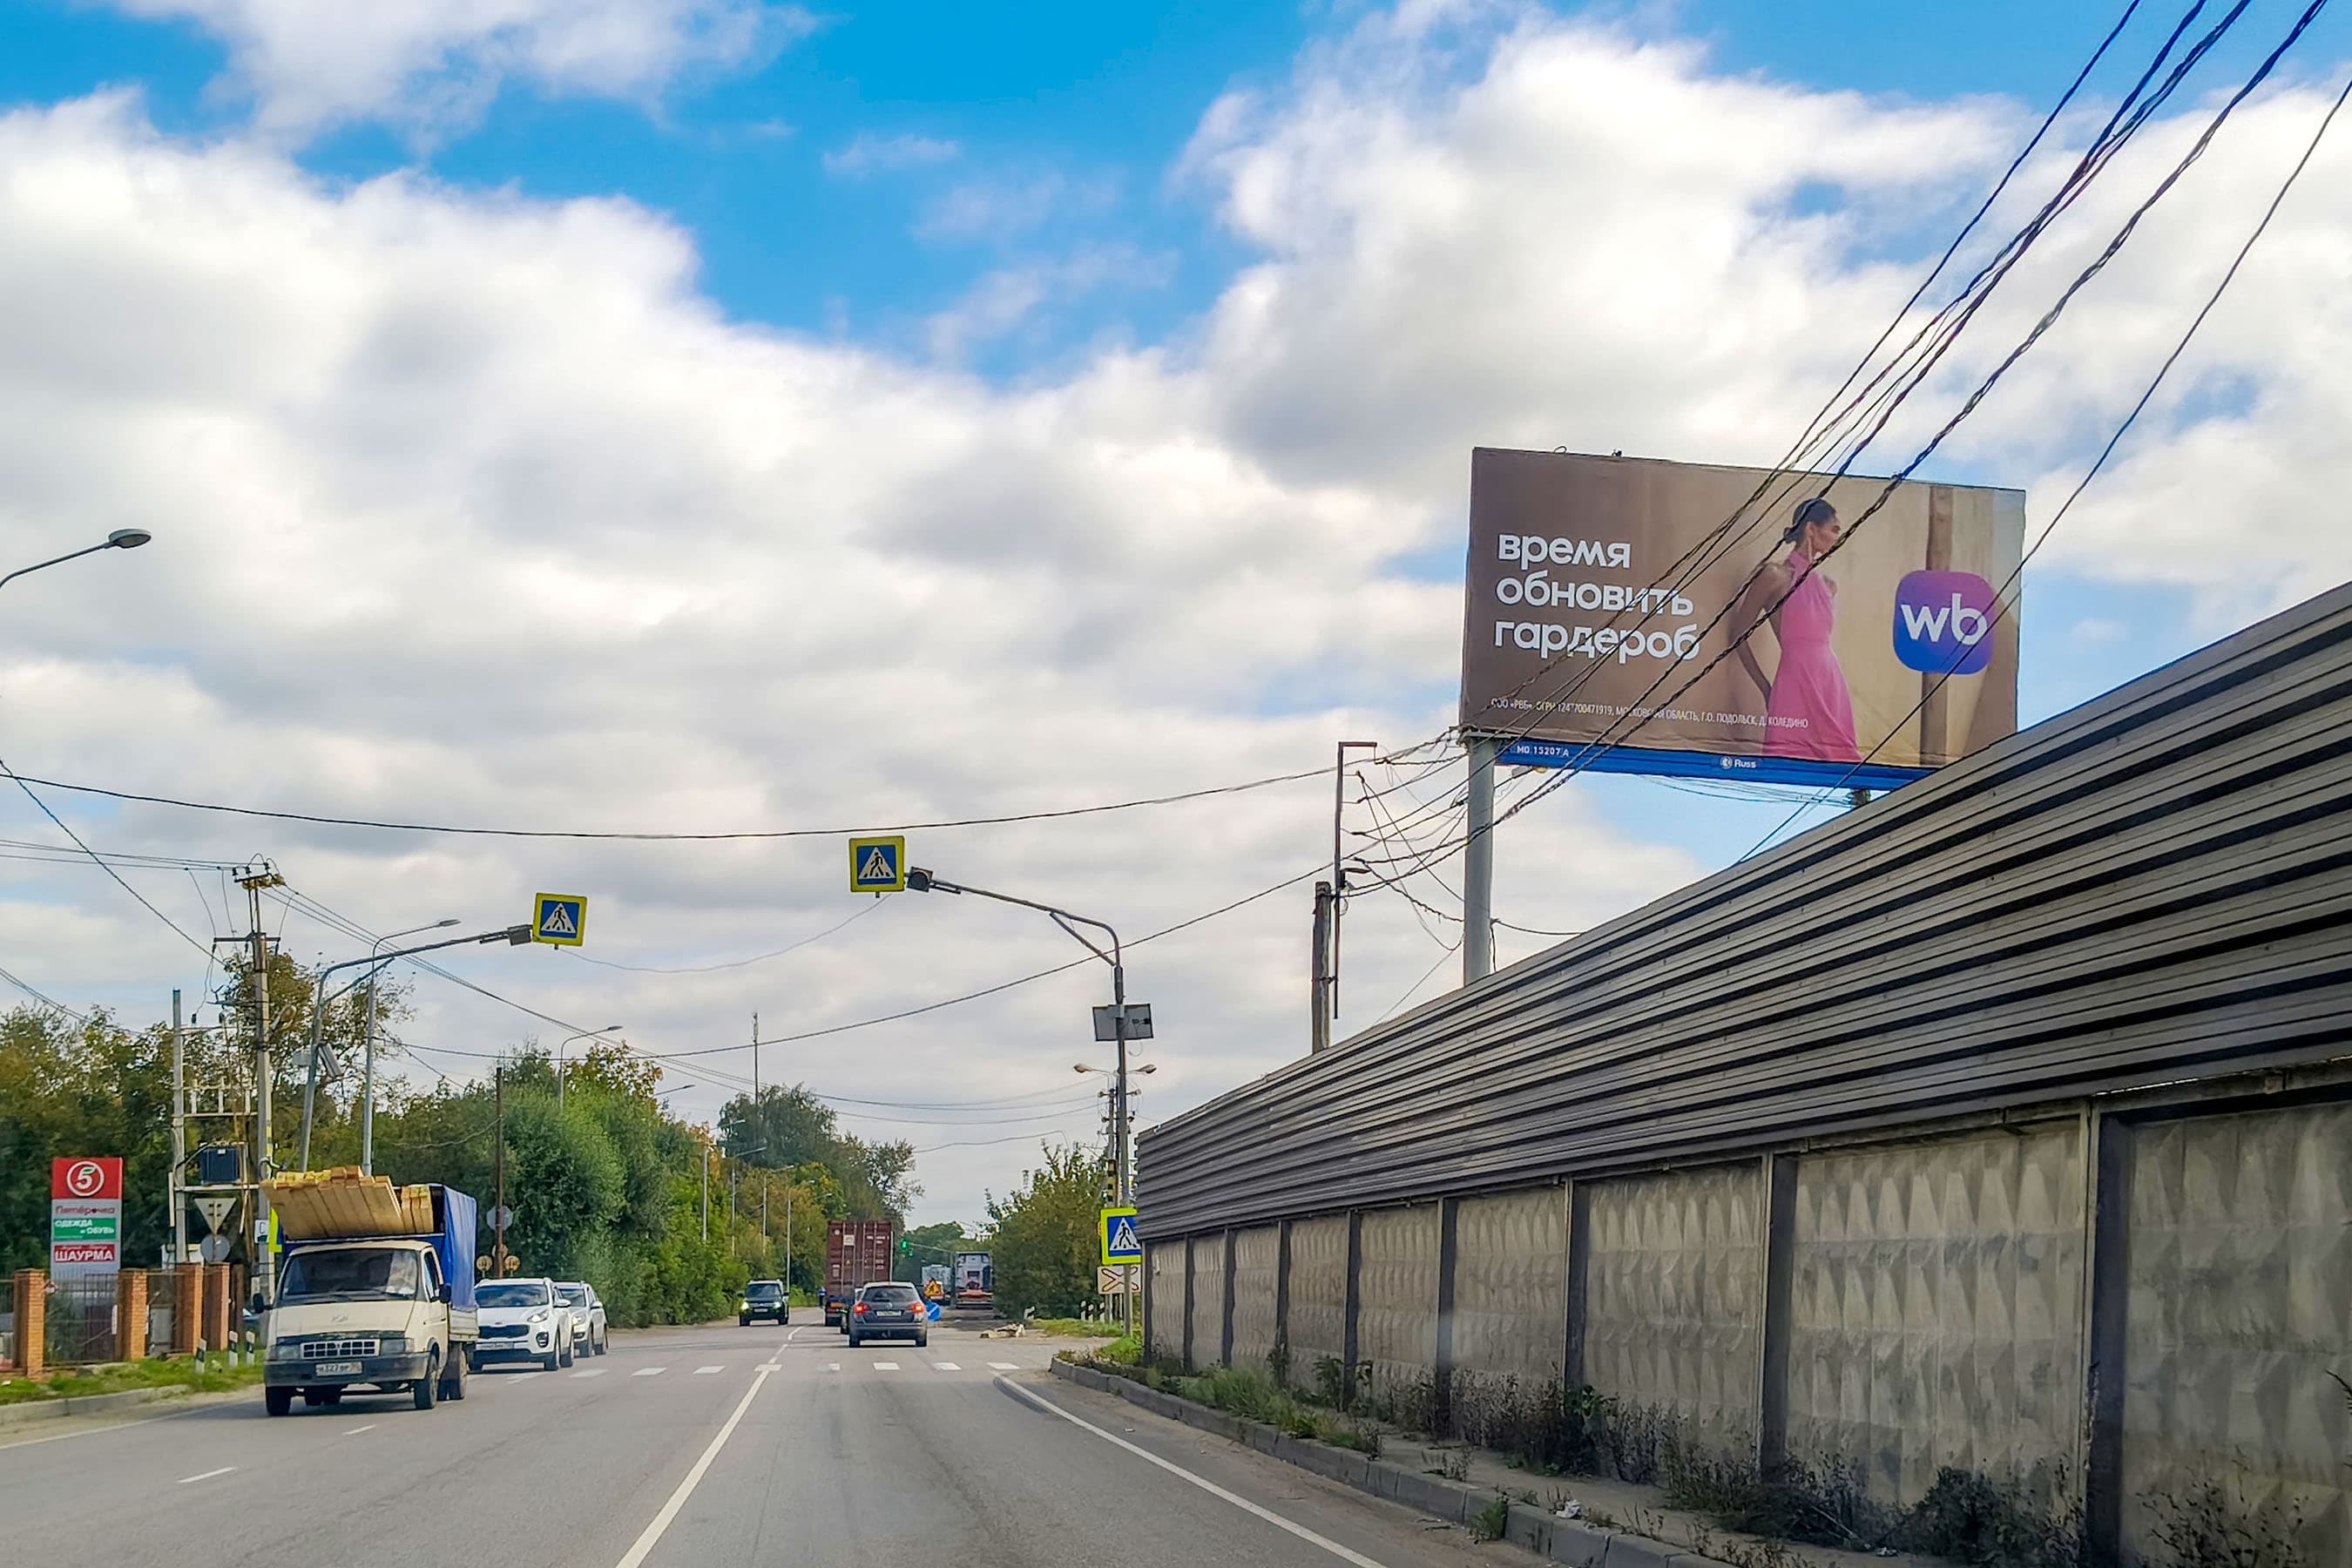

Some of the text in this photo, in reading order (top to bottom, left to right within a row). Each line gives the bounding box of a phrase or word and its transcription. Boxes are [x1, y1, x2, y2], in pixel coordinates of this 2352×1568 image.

[1497, 534, 1632, 571] время
[1496, 570, 1694, 616] обновить
[1900, 592, 1988, 645] wb
[1494, 620, 1701, 665] гардероб
[1768, 715, 1809, 729] КОЛЕДИНО
[1734, 759, 1757, 768] Russ
[76, 1166, 97, 1190] 5
[54, 1219, 93, 1228] ОДЕЖДА
[54, 1249, 113, 1262] ШАУРМА
